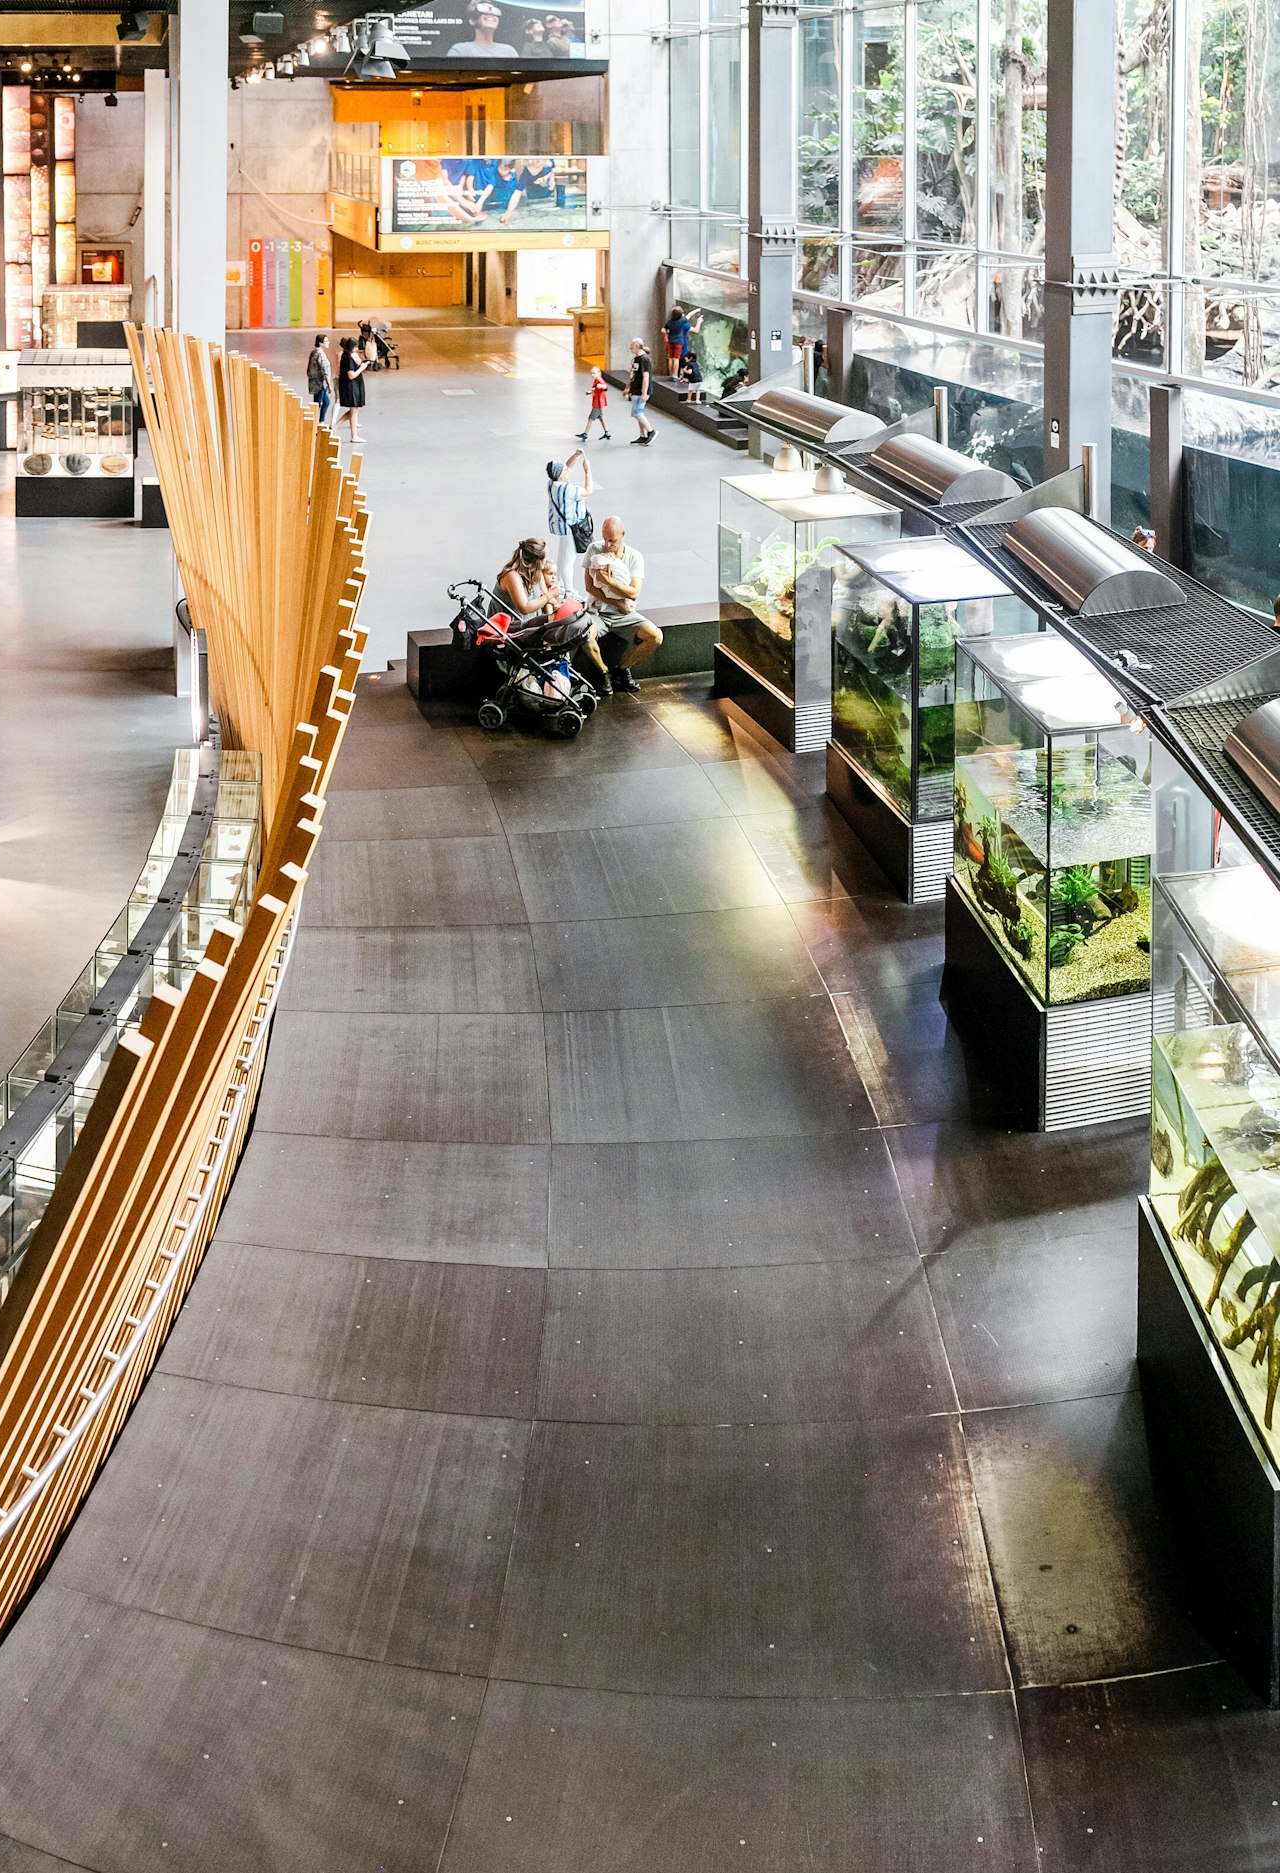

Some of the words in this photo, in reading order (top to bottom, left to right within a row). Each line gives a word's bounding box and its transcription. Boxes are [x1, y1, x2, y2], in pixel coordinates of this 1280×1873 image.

[251, 241, 261, 253] 0
[264, 241, 275, 252] -1
[277, 241, 289, 252] -2
[290, 241, 302, 252] -3
